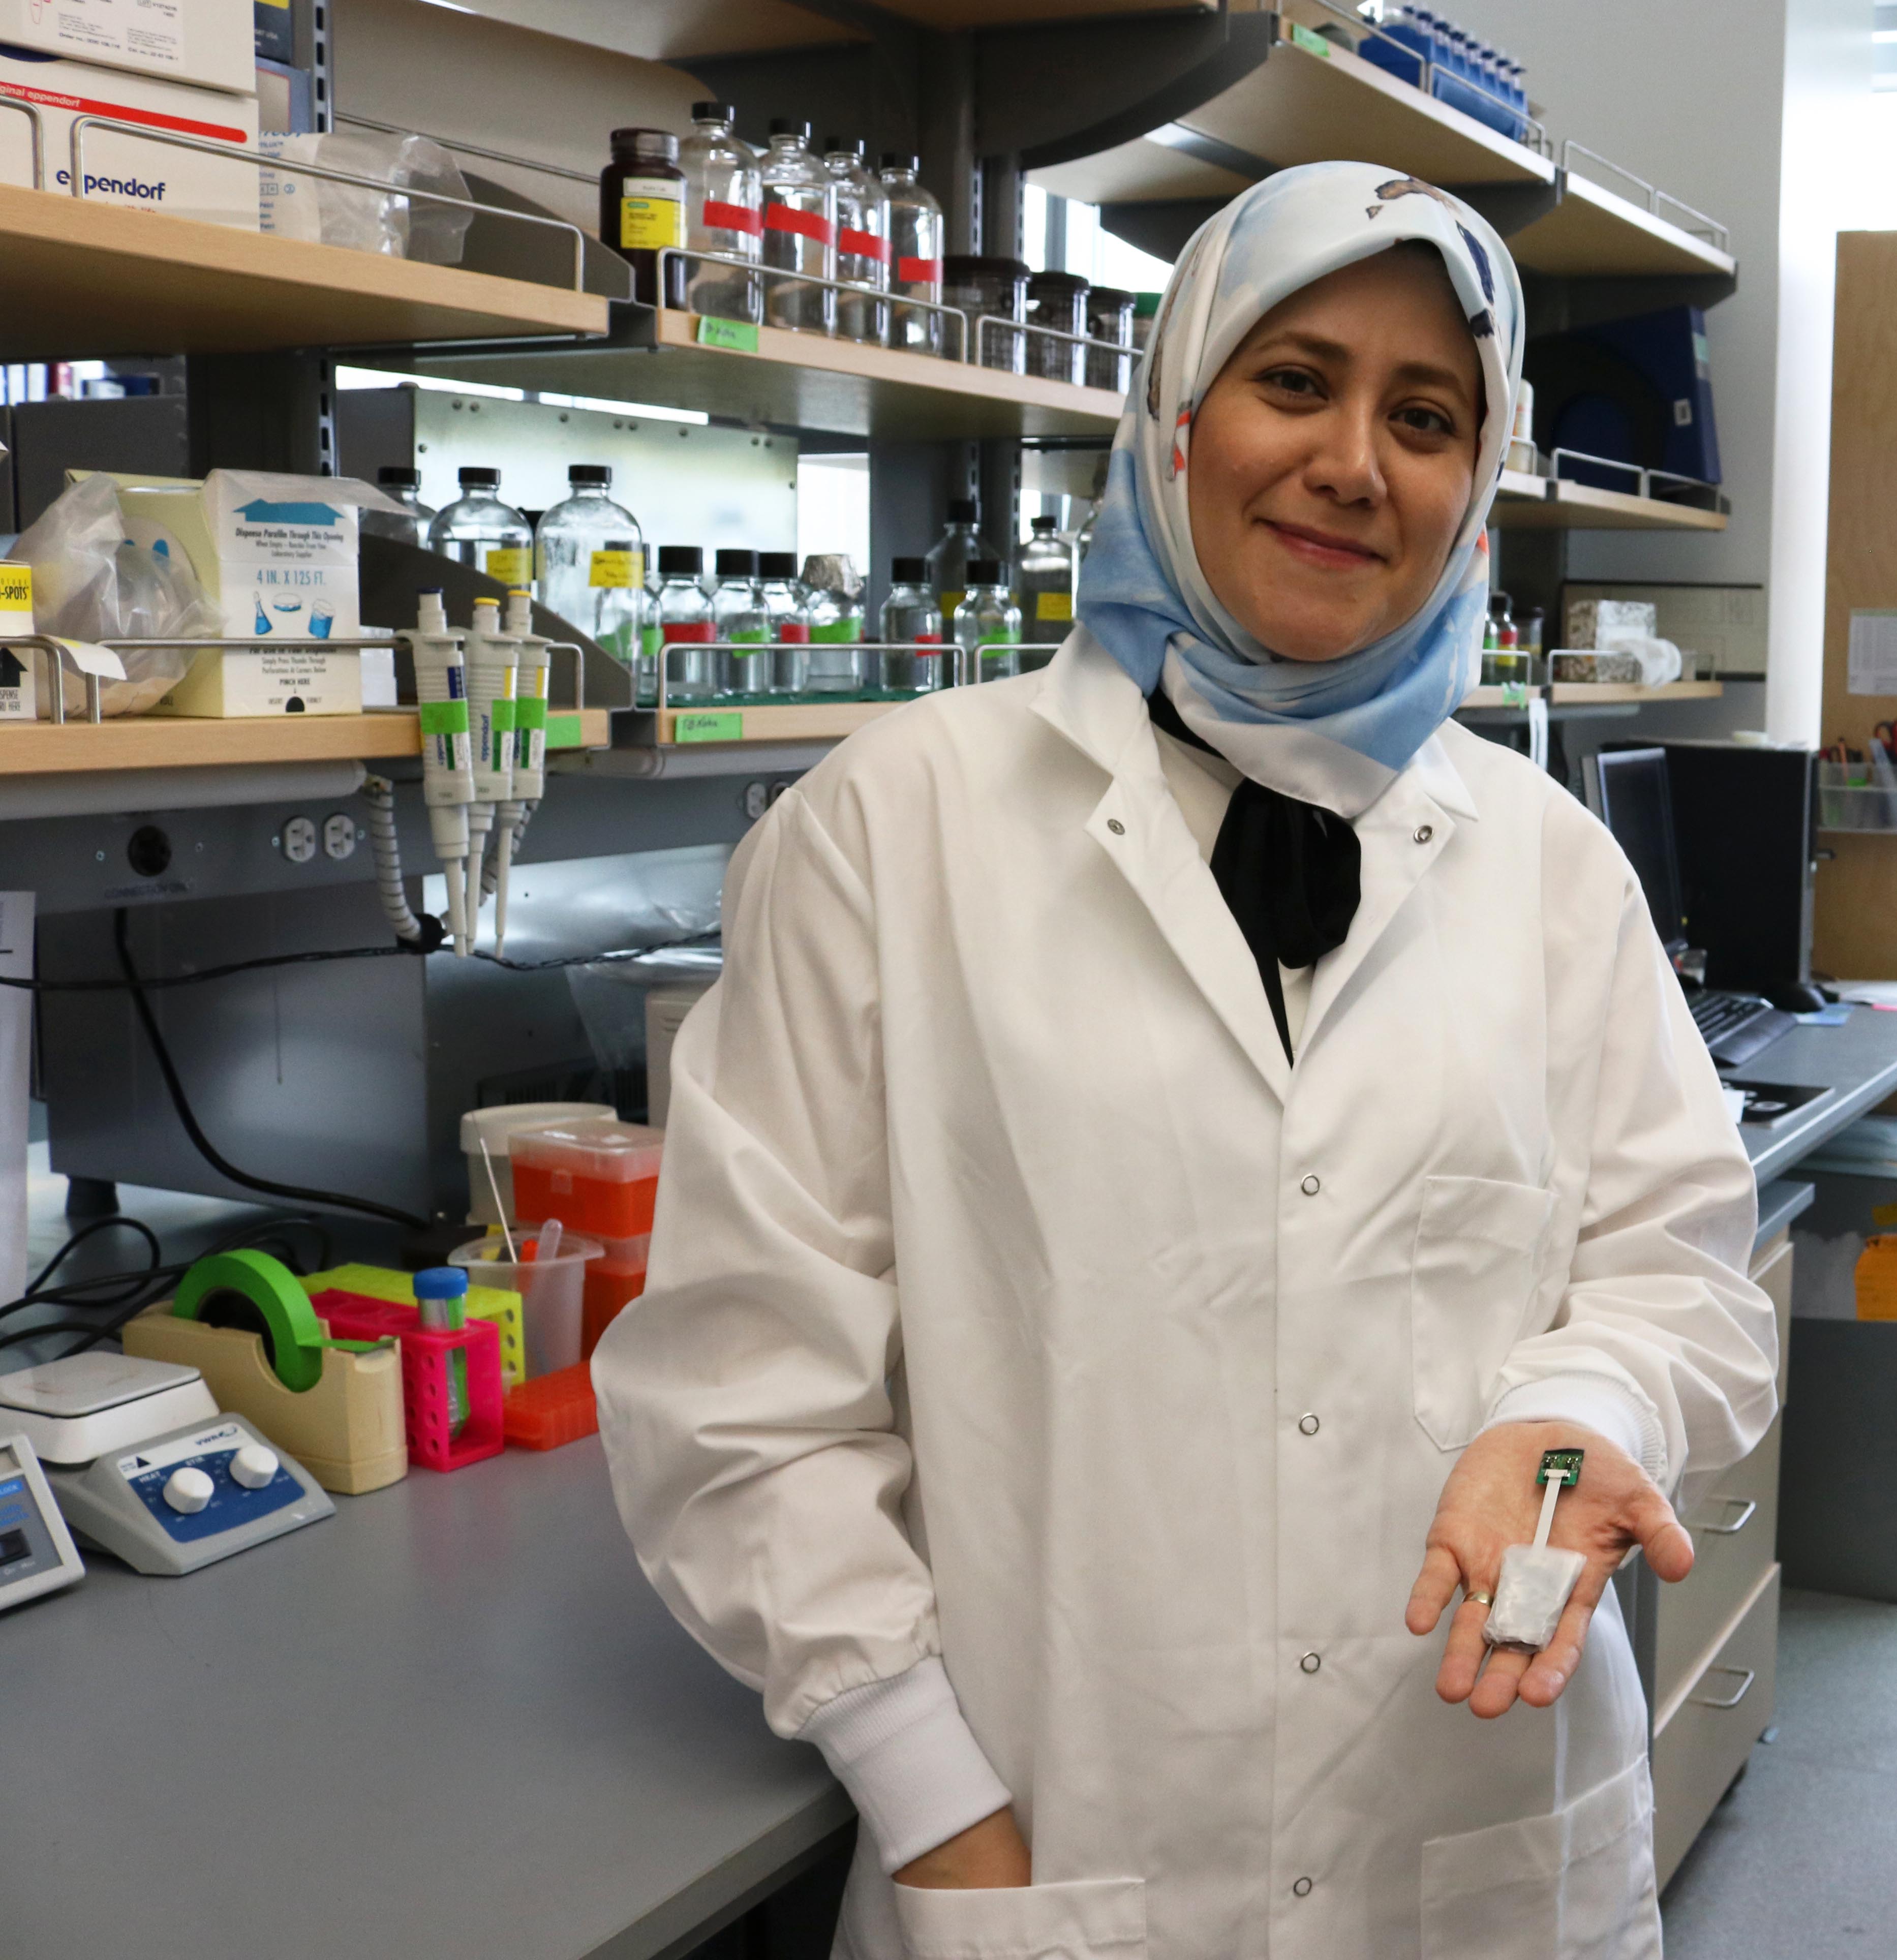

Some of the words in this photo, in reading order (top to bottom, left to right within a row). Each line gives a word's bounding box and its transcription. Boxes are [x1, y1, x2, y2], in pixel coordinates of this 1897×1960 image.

[27, 90, 80, 108] eppendorf
[56, 170, 166, 201] ependorf
[236, 527, 262, 539] Dispense
[264, 529, 287, 538] Parafilm
[289, 530, 310, 541] Through
[257, 569, 262, 584] 4
[267, 570, 280, 585] IN.
[284, 570, 289, 585] X
[294, 570, 310, 585] 125
[314, 570, 327, 585] FT.
[481, 713, 490, 761] eppendorf
[138, 1471, 161, 1483] HEAT
